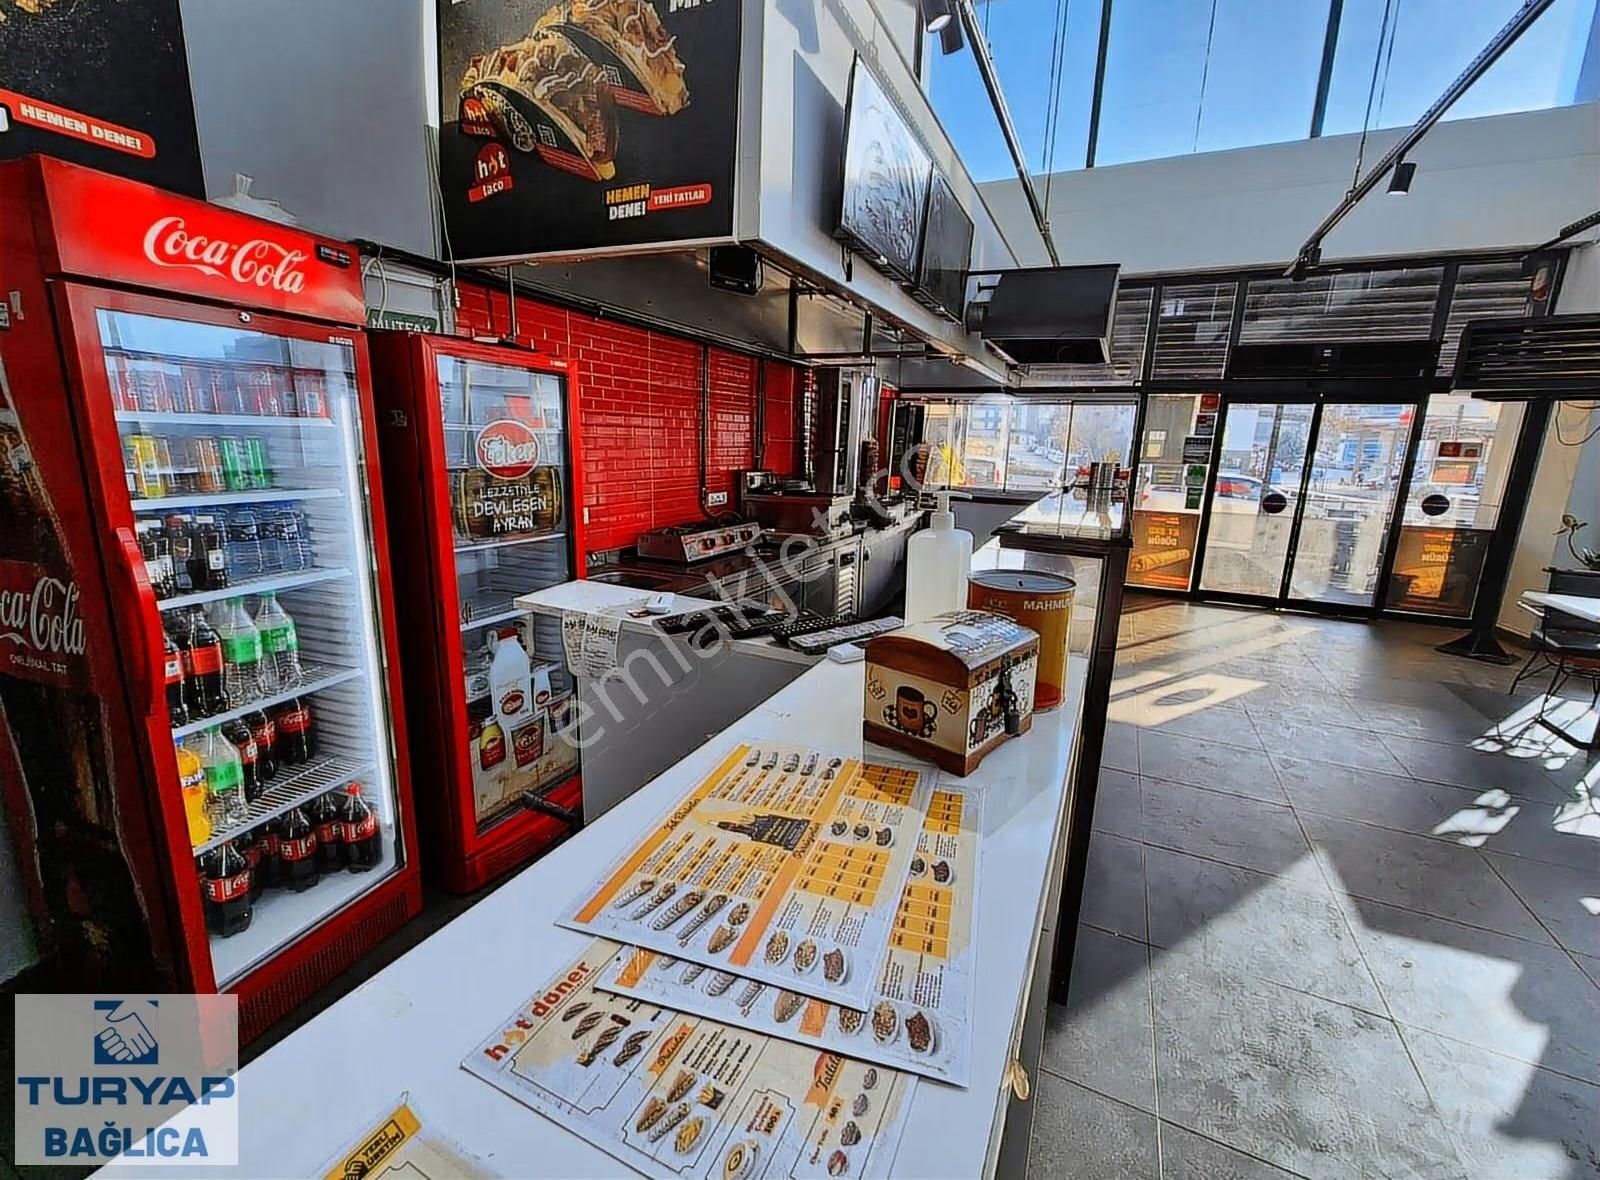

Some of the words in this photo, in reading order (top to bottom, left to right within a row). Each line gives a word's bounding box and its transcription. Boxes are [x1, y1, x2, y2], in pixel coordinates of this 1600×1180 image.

[20, 103, 88, 134] HEMEN
[477, 151, 506, 179] hot
[482, 180, 504, 197] taco
[606, 184, 650, 205] HEMEN
[674, 190, 705, 204] TATLAR
[143, 216, 309, 294] Coca-Cola
[474, 496, 547, 518] DEVLESEN
[493, 516, 534, 533] AYRAN
